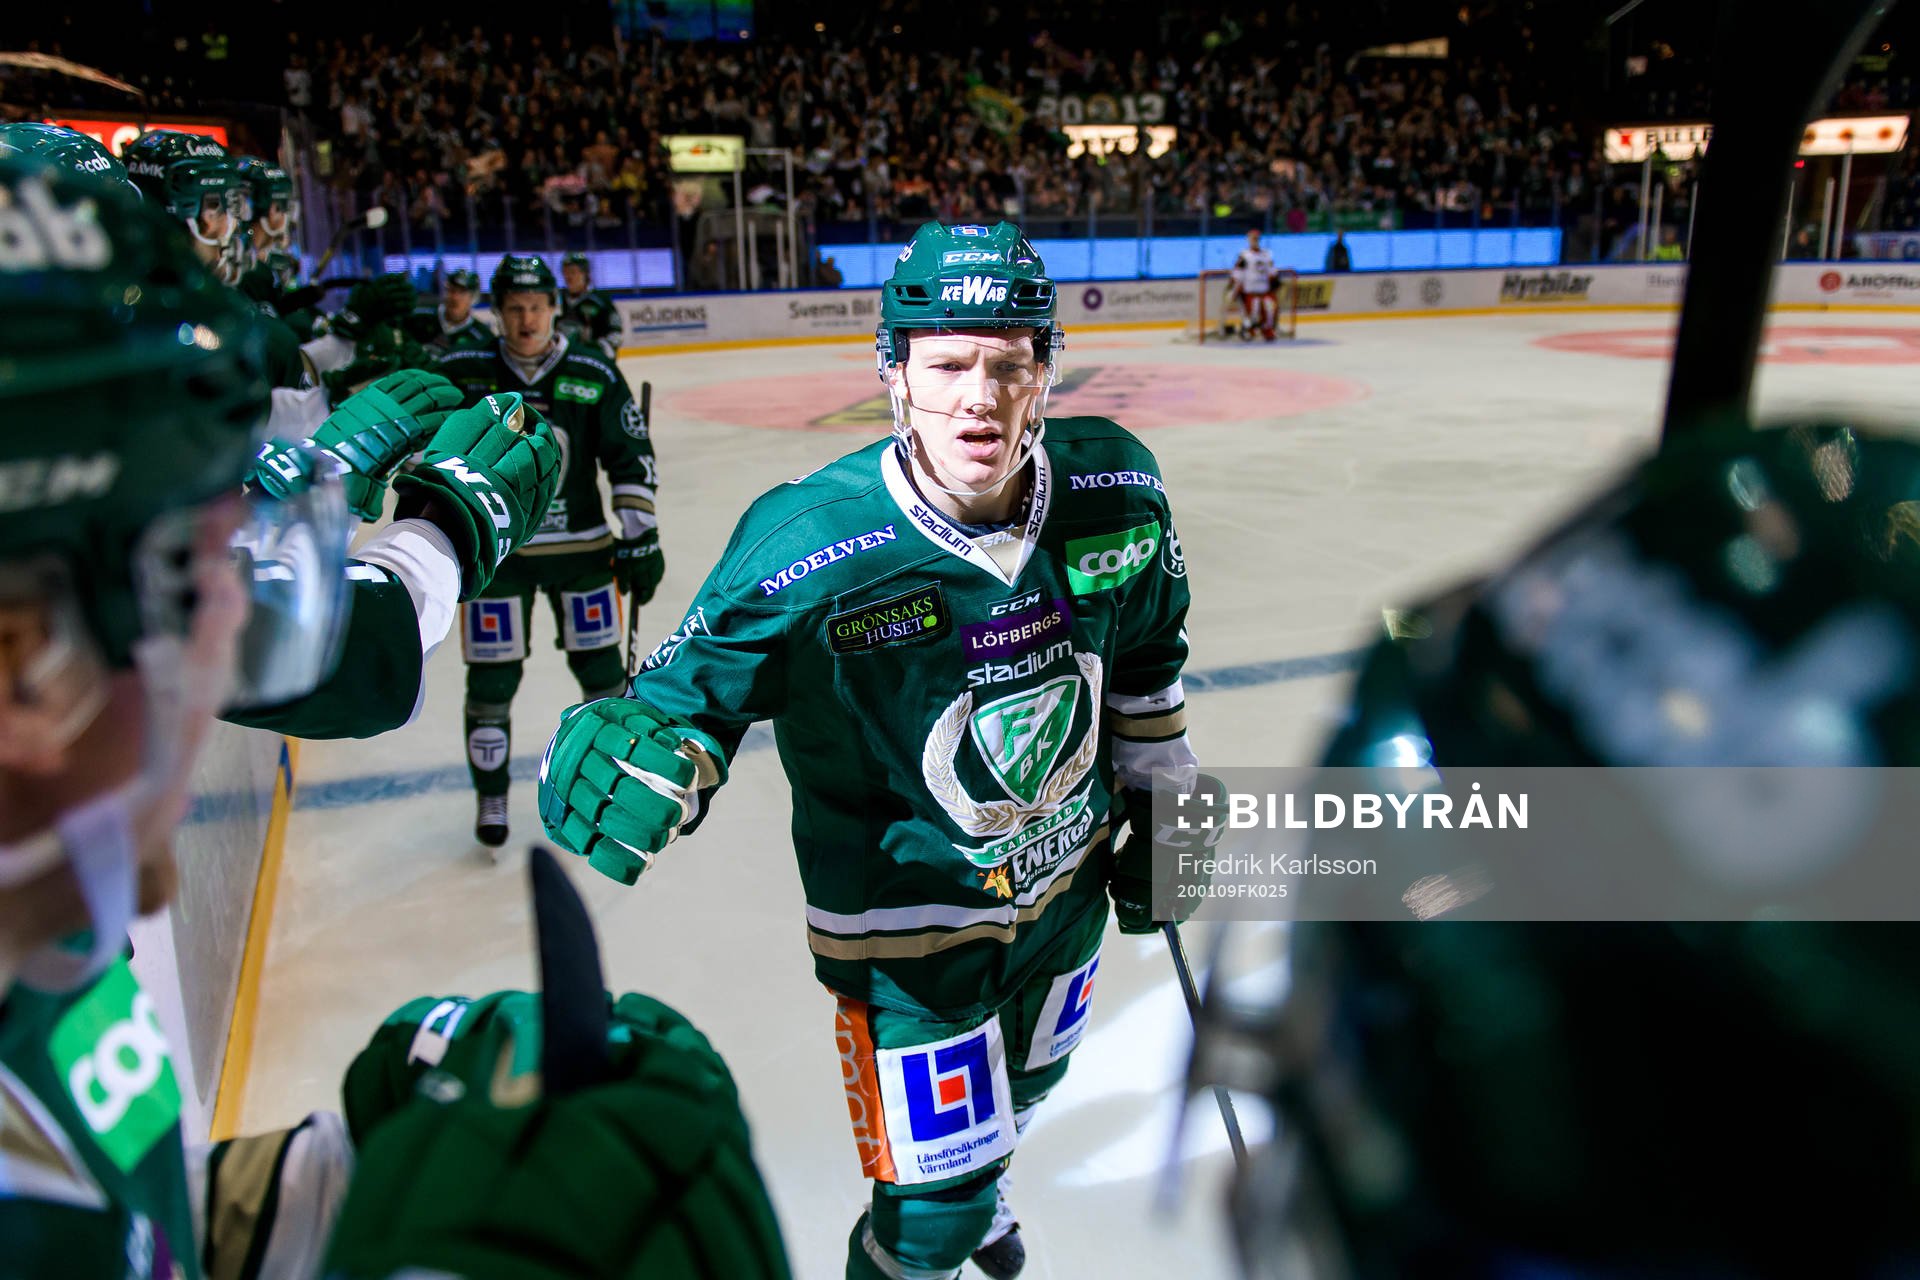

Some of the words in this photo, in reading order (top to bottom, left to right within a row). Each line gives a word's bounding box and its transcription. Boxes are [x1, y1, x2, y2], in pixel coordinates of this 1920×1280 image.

[943, 252, 1001, 265] CCM
[558, 382, 599, 402] coop
[1069, 471, 1166, 493] MOELVE
[1027, 466, 1047, 538] stadium
[909, 504, 974, 557] stadium
[760, 525, 898, 597] MOELVEN
[1079, 537, 1156, 577] coop
[836, 595, 933, 638] GRÖNSAKS
[990, 592, 1041, 617] CCM
[865, 615, 925, 646] HUSET
[971, 611, 1062, 649] LÖFBERGS
[967, 640, 1073, 689] stadium
[993, 805, 1074, 858] KARLSTAD
[916, 1129, 1000, 1165] Länsförsäkringar
[918, 1152, 972, 1175] Värmland
